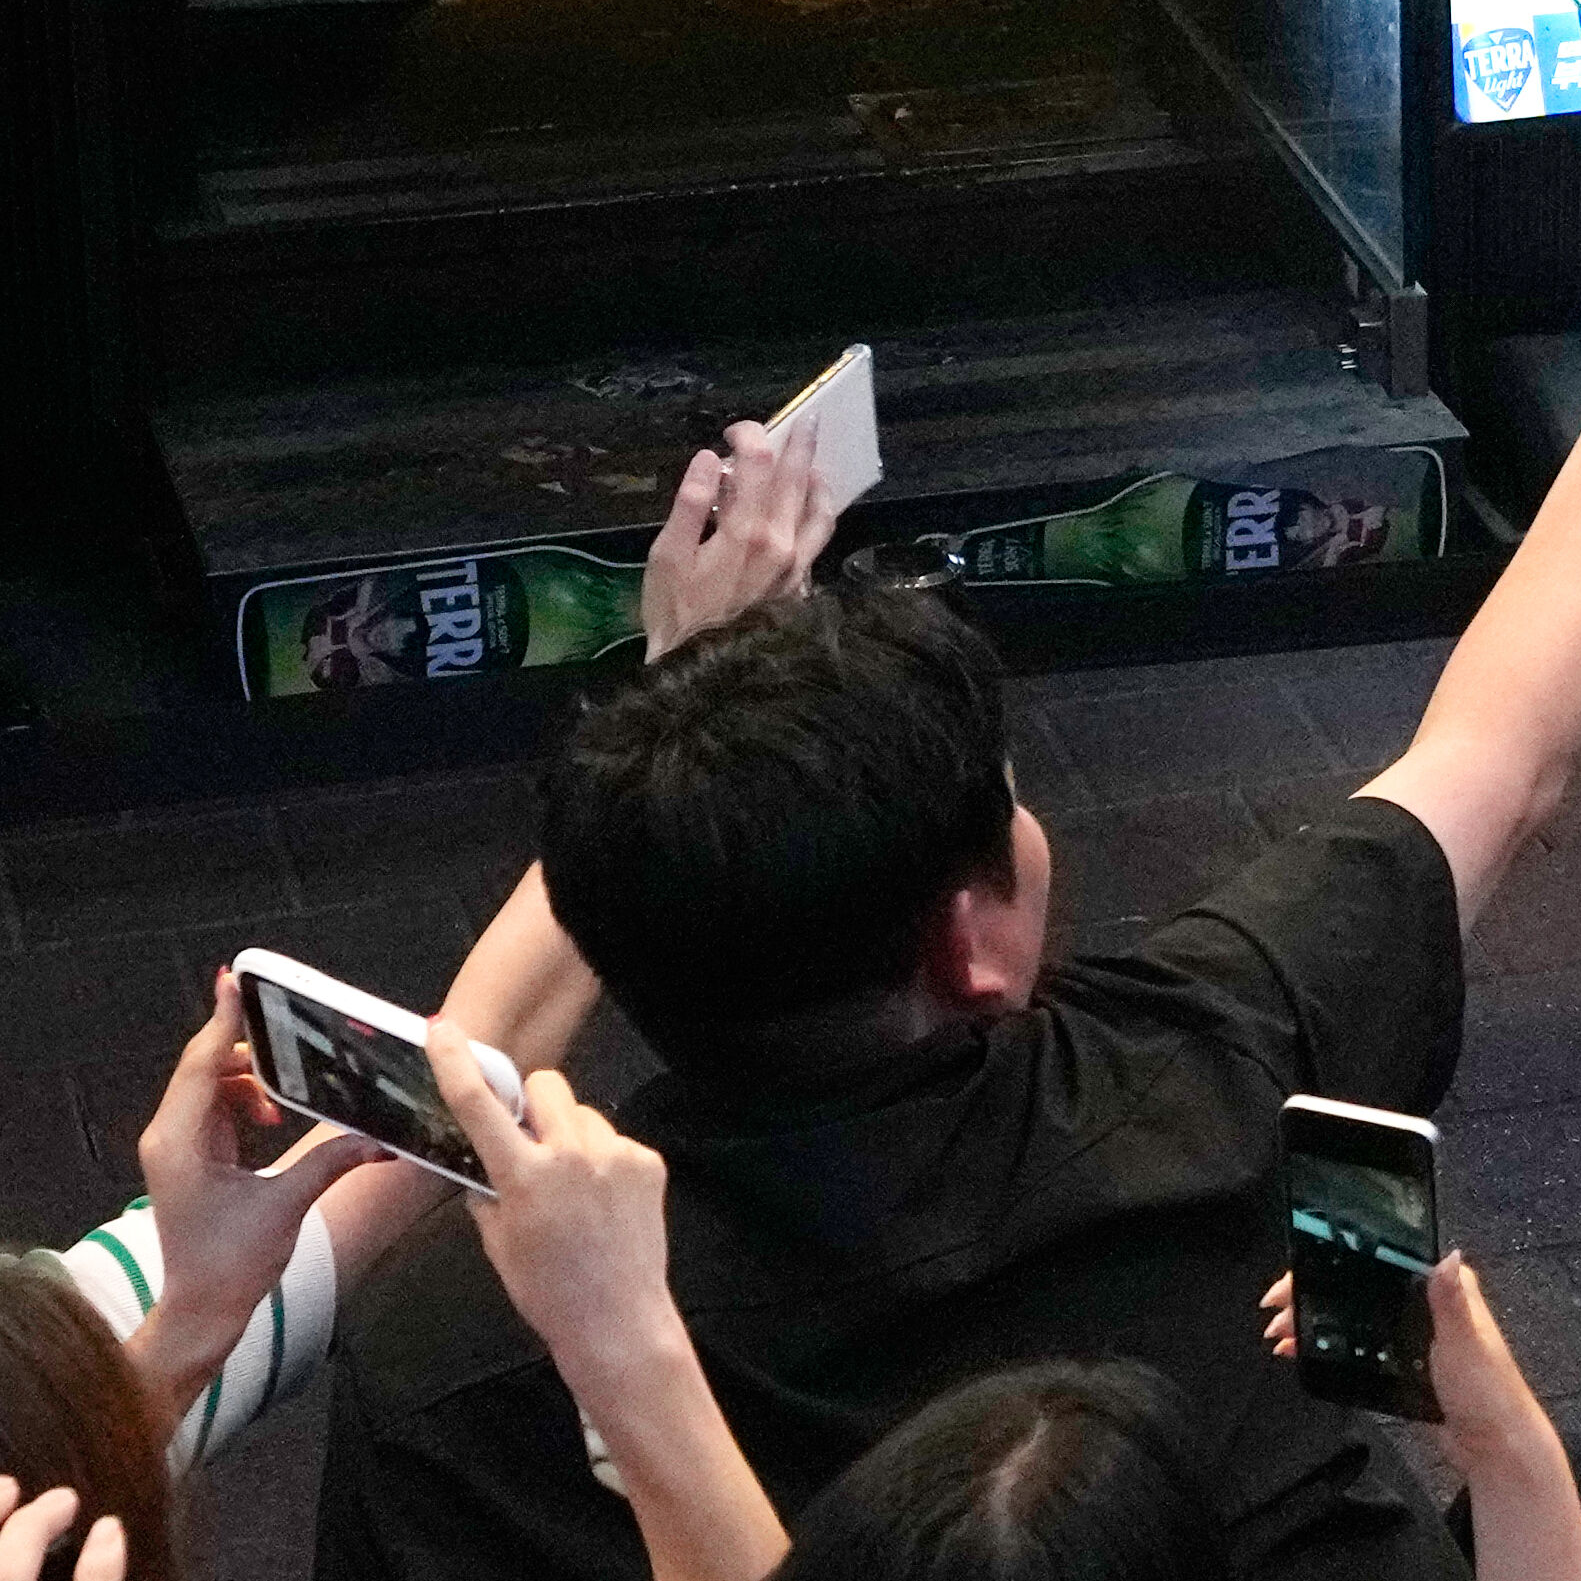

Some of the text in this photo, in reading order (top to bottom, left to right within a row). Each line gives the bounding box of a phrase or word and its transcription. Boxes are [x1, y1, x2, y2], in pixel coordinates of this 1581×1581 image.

[1464, 40, 1535, 80] TERRA
[1484, 70, 1524, 97] light
[1225, 486, 1281, 576] ERR
